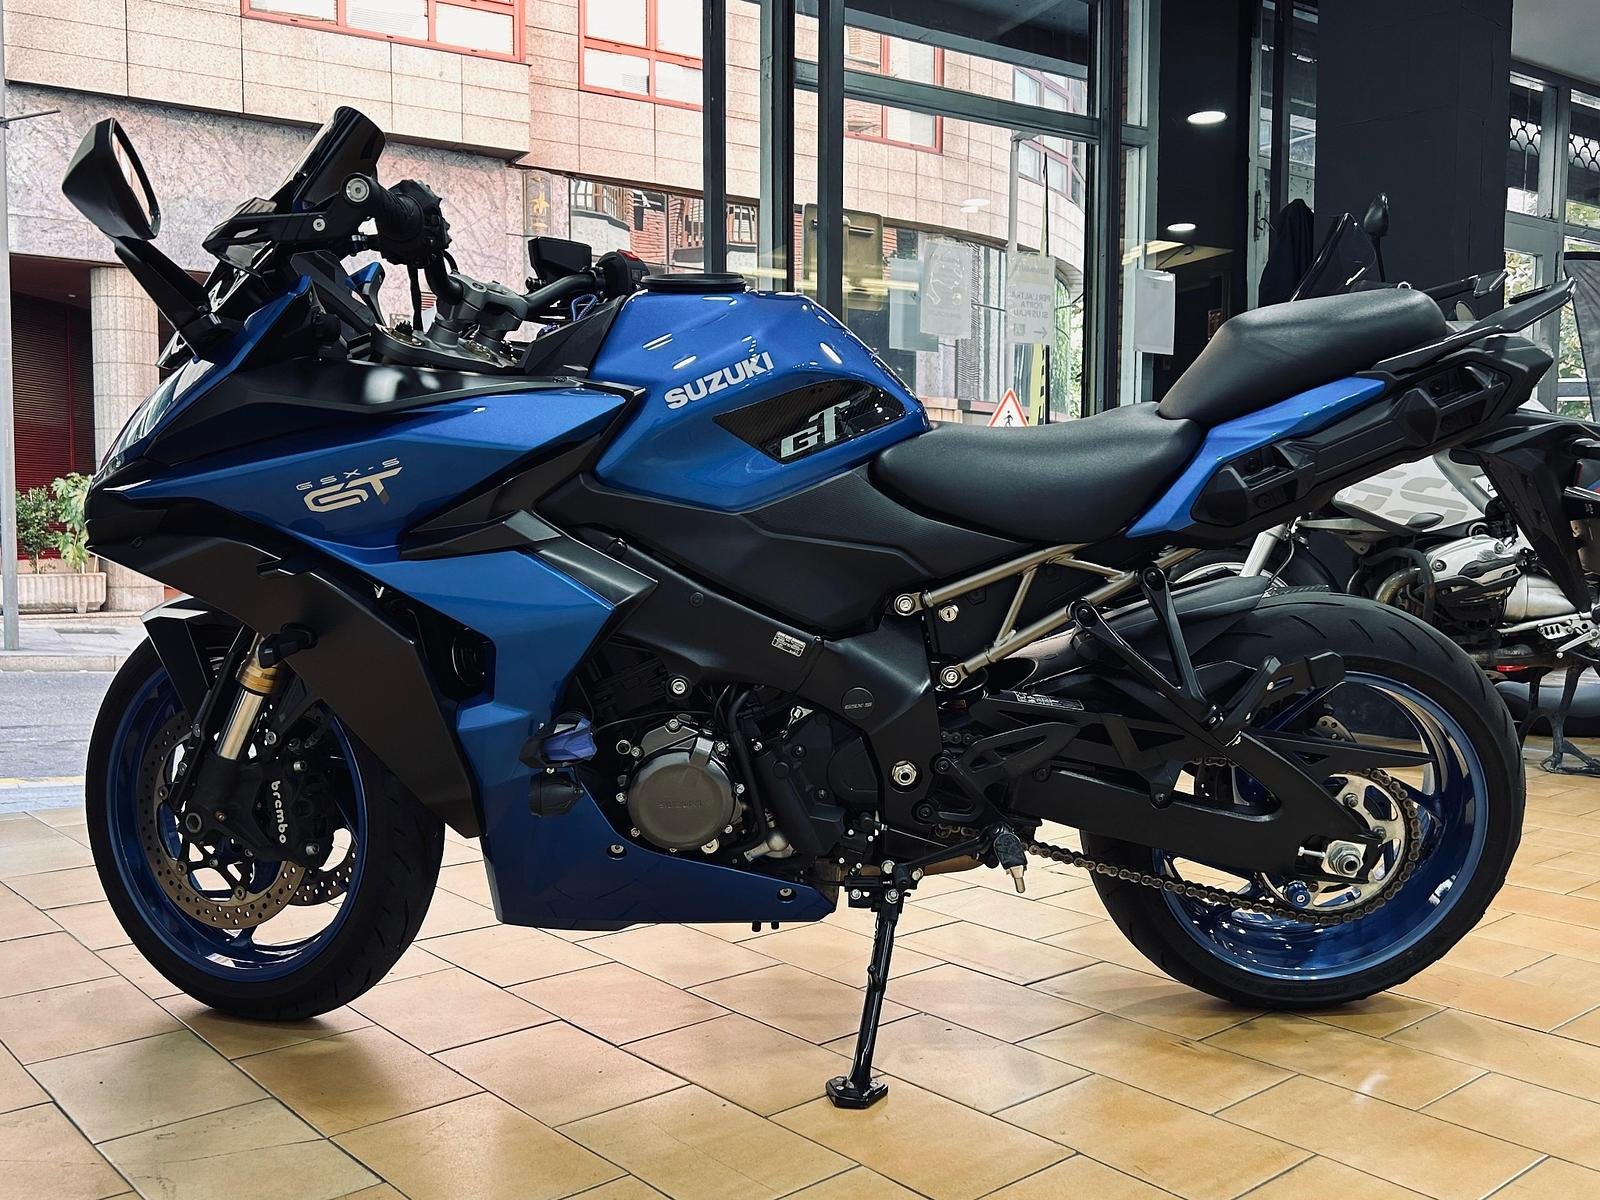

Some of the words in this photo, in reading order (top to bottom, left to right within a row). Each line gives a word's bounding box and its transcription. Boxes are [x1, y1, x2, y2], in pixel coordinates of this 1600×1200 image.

[664, 351, 774, 409] SUZUKI
[780, 400, 851, 458] GT
[296, 457, 400, 491] GSX-S
[303, 466, 403, 513] GT
[271, 780, 288, 844] brembo
